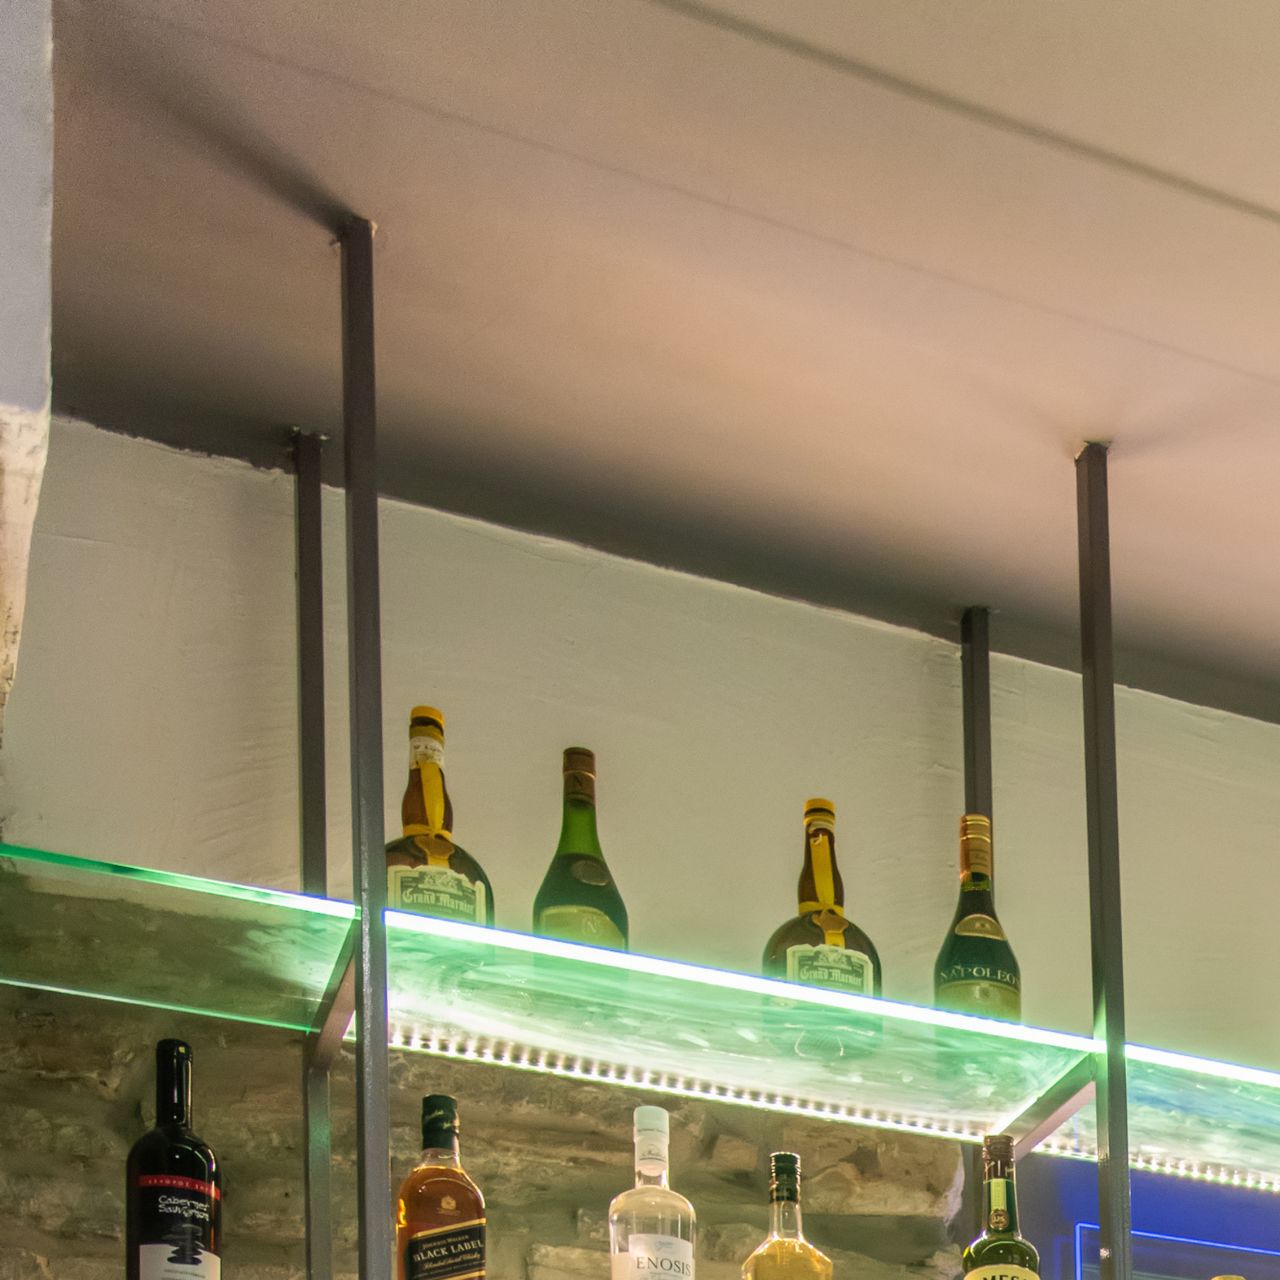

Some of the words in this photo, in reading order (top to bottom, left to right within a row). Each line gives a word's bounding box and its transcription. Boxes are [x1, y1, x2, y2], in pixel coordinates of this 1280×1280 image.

[402, 888, 435, 904] Grand
[800, 964, 829, 980] Grand
[158, 1195, 210, 1212] Cabernet
[158, 1204, 210, 1222] Sauvignon
[412, 1246, 449, 1262] BLACK
[450, 1239, 485, 1254] LABEL
[636, 1255, 692, 1276] ENOSIS
